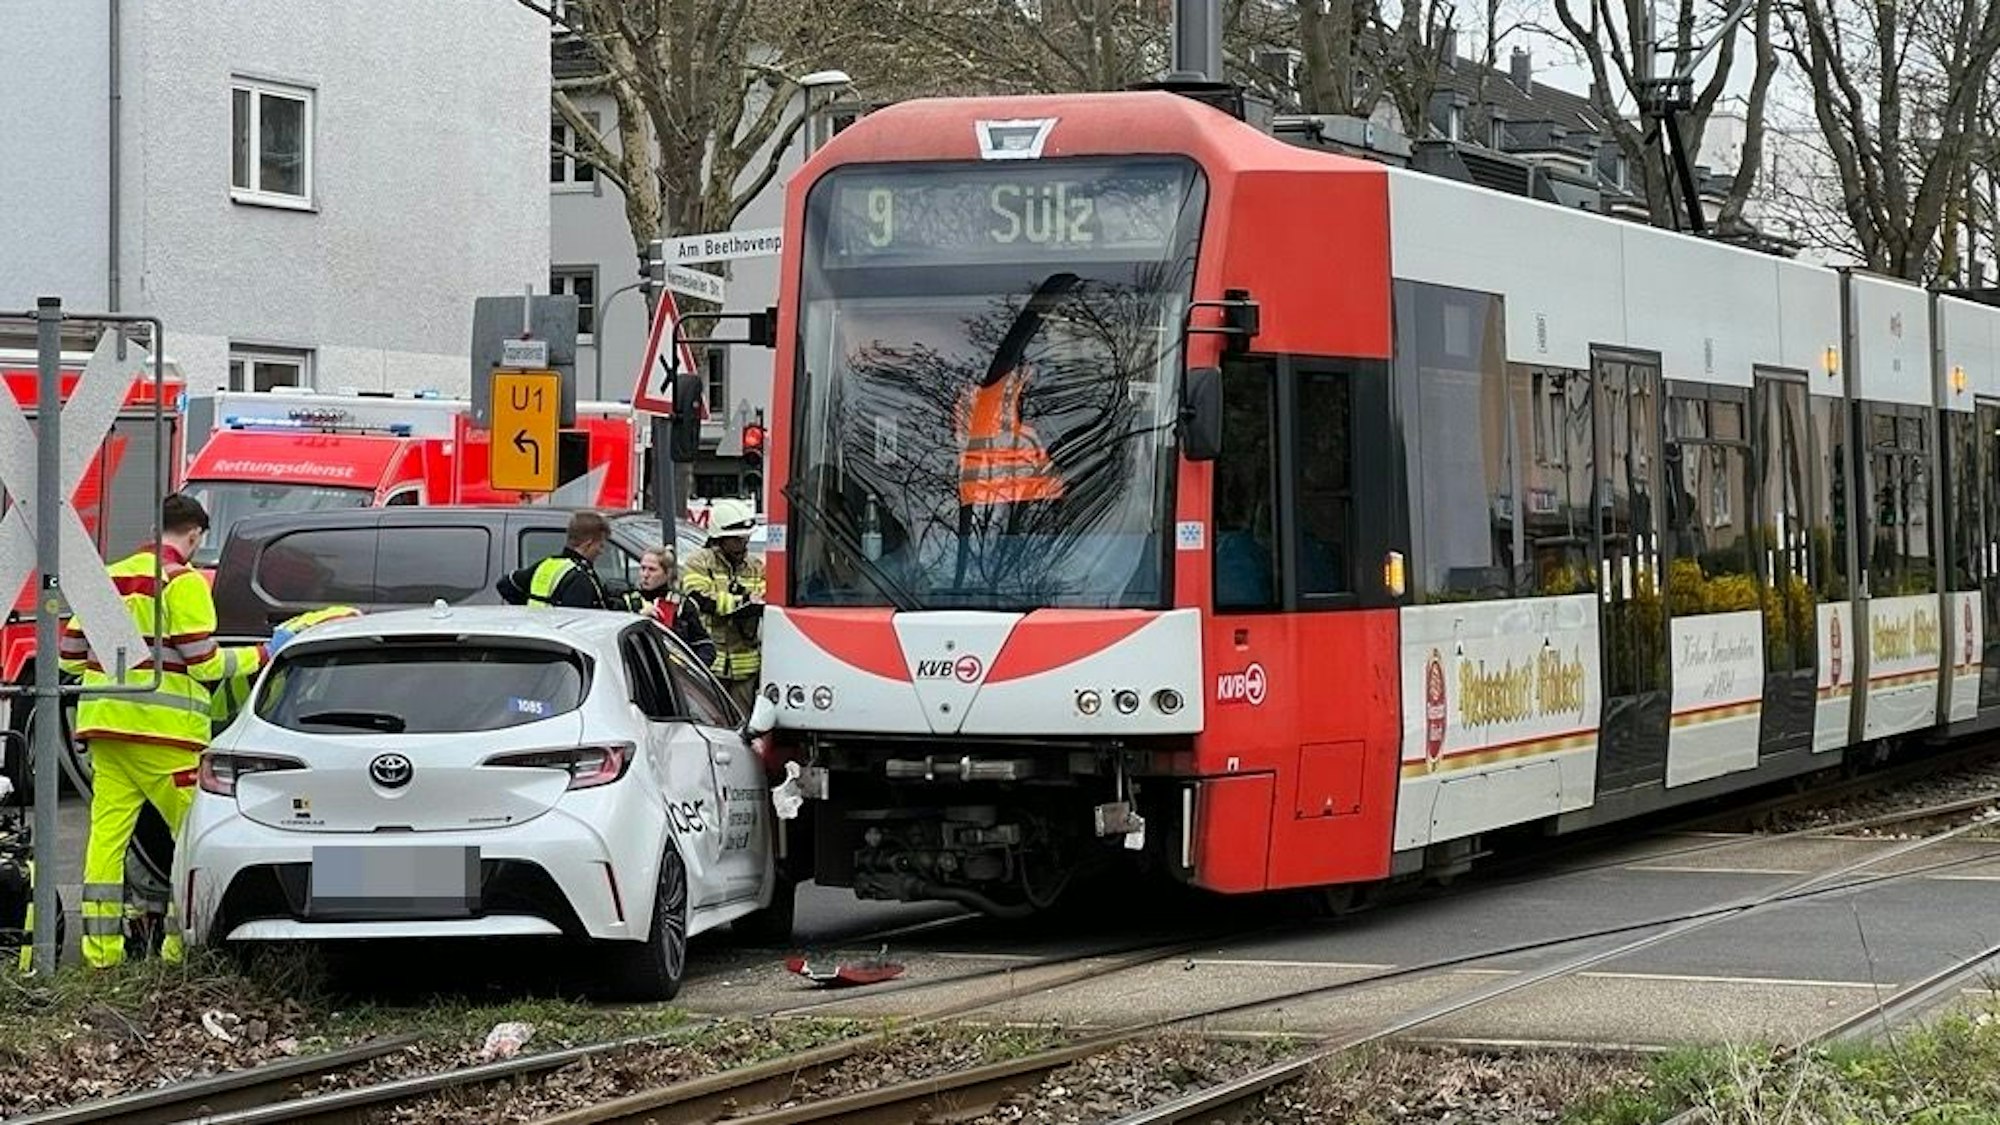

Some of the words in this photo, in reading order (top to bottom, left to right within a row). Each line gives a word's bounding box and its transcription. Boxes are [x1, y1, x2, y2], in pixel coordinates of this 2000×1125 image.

[867, 188, 894, 248] 9
[990, 182, 1094, 244] Sülz
[678, 242, 700, 258] Am
[512, 385, 543, 414] U1
[212, 459, 357, 478] Rettungsdienst
[917, 660, 953, 677] KVB
[1217, 673, 1246, 701] KVB
[662, 792, 708, 834] ber
